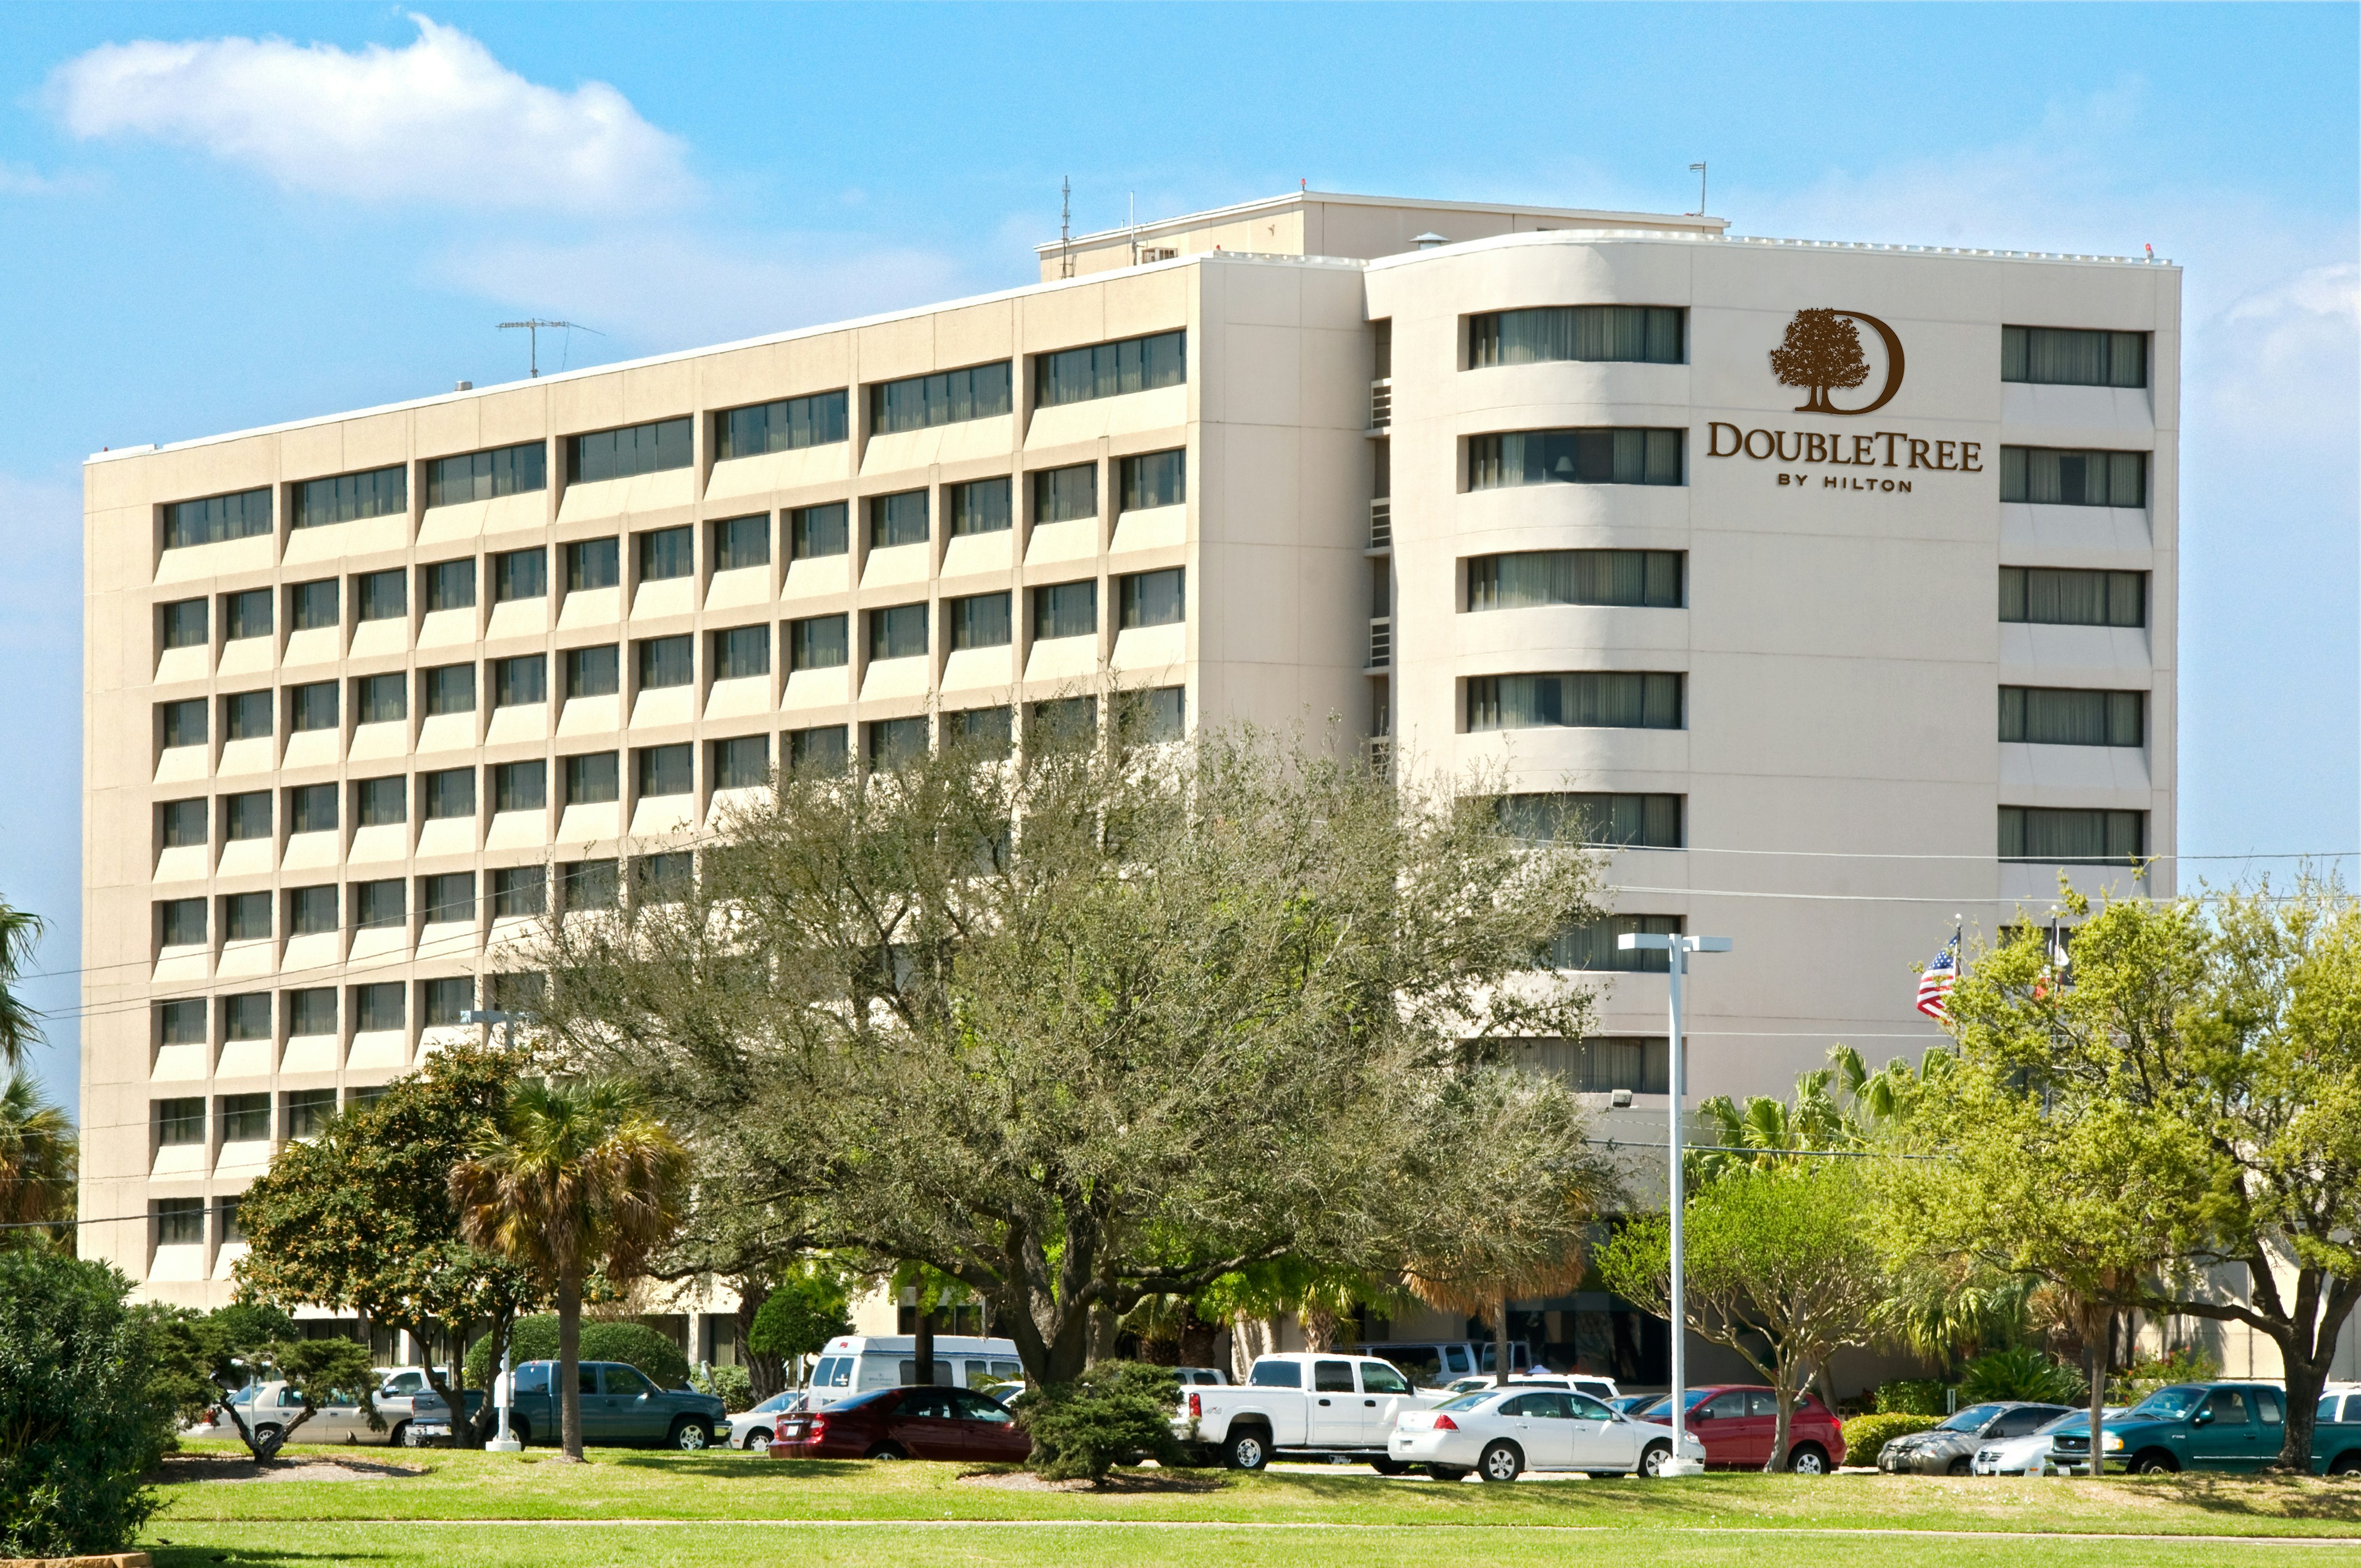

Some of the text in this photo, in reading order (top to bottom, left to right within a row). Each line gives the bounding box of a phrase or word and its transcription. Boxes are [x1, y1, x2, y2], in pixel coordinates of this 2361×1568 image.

[1707, 422, 1983, 472] DOUBLETREE
[1778, 473, 1912, 493] BY HILTON
